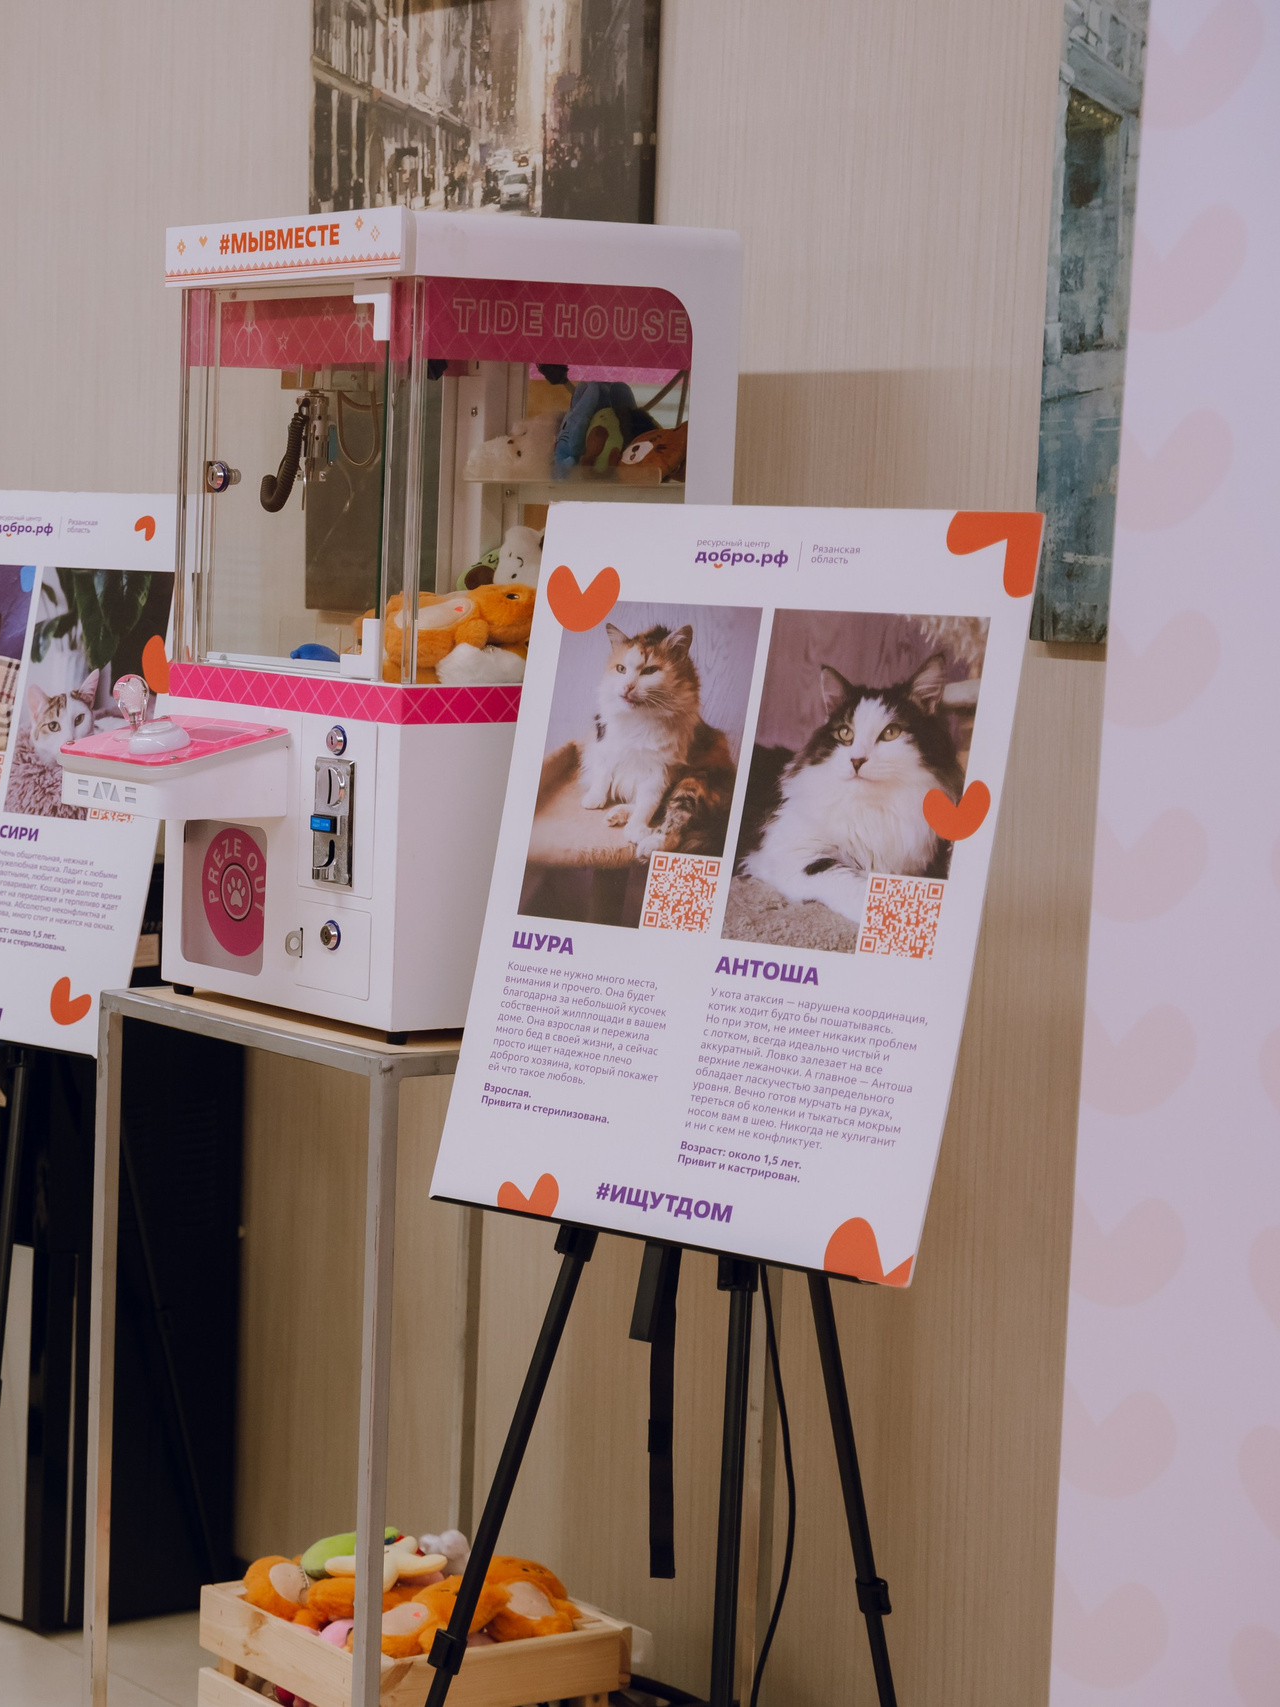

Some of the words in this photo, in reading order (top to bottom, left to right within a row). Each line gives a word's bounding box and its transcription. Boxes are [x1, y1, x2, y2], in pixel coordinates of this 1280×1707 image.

[219, 223, 340, 255] #МЫВМЕСТЕ
[453, 298, 543, 337] TIDE
[554, 303, 688, 345] HOUSE
[67, 526, 91, 534] область
[68, 518, 99, 526] Рязанская
[695, 548, 789, 568] добро.рф
[696, 539, 743, 549] ресурсный
[744, 540, 770, 549] центр
[812, 544, 861, 555] Рязанская
[811, 555, 849, 565] область
[0, 825, 40, 842] СИРИ
[208, 837, 242, 904] PREZE
[9, 928, 32, 937] около
[32, 929, 43, 940] 1,5
[42, 932, 57, 941] лет.
[12, 938, 67, 952] стерилизована.
[512, 931, 574, 955] ШУРА
[507, 960, 549, 976] Кошечке
[549, 968, 562, 977] не
[563, 970, 594, 981] нужно
[595, 974, 626, 985] много
[626, 978, 658, 992] места,
[715, 956, 820, 986] АНТОША
[502, 985, 558, 1003] благодарна
[558, 995, 570, 1004] за
[571, 996, 627, 1012] небольшой
[627, 1005, 667, 1017] кусочек
[504, 975, 552, 989] внимания
[552, 981, 560, 990] и
[560, 982, 603, 996] прочего.
[605, 986, 625, 998] Она
[626, 989, 656, 1003] будет
[496, 1011, 524, 1024] доме.
[526, 1015, 546, 1027] Она
[546, 1019, 592, 1033] взрослая
[592, 1026, 600, 1034] и
[600, 1027, 650, 1042] пережила
[500, 999, 561, 1016] собственной
[561, 1009, 625, 1026] жилплощади
[625, 1017, 633, 1026] в
[633, 1018, 667, 1031] вашем
[707, 1002, 738, 1014] котик
[738, 1006, 770, 1018] ходит
[770, 1007, 801, 1022] будто
[802, 1012, 818, 1024] бы
[819, 1017, 897, 1040] пошатываясь.
[492, 1037, 526, 1050] просто
[527, 1043, 553, 1054] ищет
[553, 1046, 602, 1061] надежное
[602, 1054, 633, 1066] плечо
[495, 1025, 524, 1037] много
[525, 1027, 544, 1041] бед
[544, 1032, 551, 1041] в
[552, 1033, 581, 1045] своей
[581, 1038, 615, 1052] жизни,
[617, 1043, 624, 1051] а
[625, 1043, 659, 1057] сейчас
[702, 1028, 709, 1037] с
[710, 1029, 750, 1044] лотком,
[752, 1035, 787, 1049] всегда
[788, 1040, 840, 1055] идеально
[841, 1047, 881, 1061] чистый
[882, 1053, 891, 1062] и
[487, 1061, 500, 1072] ей
[501, 1064, 518, 1075] что
[518, 1067, 546, 1079] такое
[546, 1071, 586, 1085] любовь.
[489, 1049, 530, 1064] доброго
[530, 1056, 572, 1072] хозяина,
[573, 1063, 616, 1076] который
[616, 1069, 659, 1083] покажет
[700, 1041, 764, 1058] аккуратный.
[765, 1048, 799, 1063] Ловко
[799, 1055, 848, 1070] залезает
[849, 1062, 863, 1072] на
[864, 1064, 883, 1080] все
[483, 1082, 532, 1099] Взрослая.
[691, 1081, 732, 1095] уровня.
[733, 1084, 766, 1099] Вечно
[767, 1092, 797, 1104] готов
[798, 1097, 842, 1111] мурчать
[843, 1103, 858, 1113] на
[858, 1106, 893, 1121] руках,
[695, 1066, 744, 1082] обладает
[744, 1075, 812, 1092] ласкучестью
[812, 1085, 895, 1105] запредельного
[480, 1094, 522, 1110] Привита
[523, 1103, 531, 1112] и
[531, 1104, 610, 1124] стерилизована.
[690, 1093, 736, 1108] тереться
[736, 1099, 751, 1111] об
[752, 1103, 796, 1118] коленки
[797, 1110, 806, 1119] и
[807, 1111, 856, 1127] тыкаться
[857, 1120, 902, 1135] мокрым
[687, 1107, 720, 1120] носом
[720, 1112, 741, 1123] вам
[742, 1115, 749, 1124] в
[750, 1117, 777, 1129] шею.
[779, 1119, 824, 1137] Никогда
[825, 1129, 840, 1139] не
[840, 1131, 897, 1148] хулиганит
[677, 1153, 718, 1169] Привит
[718, 1162, 726, 1171] и
[727, 1163, 801, 1184] кастрирован.
[679, 1140, 727, 1157] Возраст:
[727, 1150, 762, 1163] около
[763, 1154, 779, 1167] 1,5
[779, 1159, 802, 1170] лет.
[596, 1182, 733, 1224] #ИЩУТДОМ
